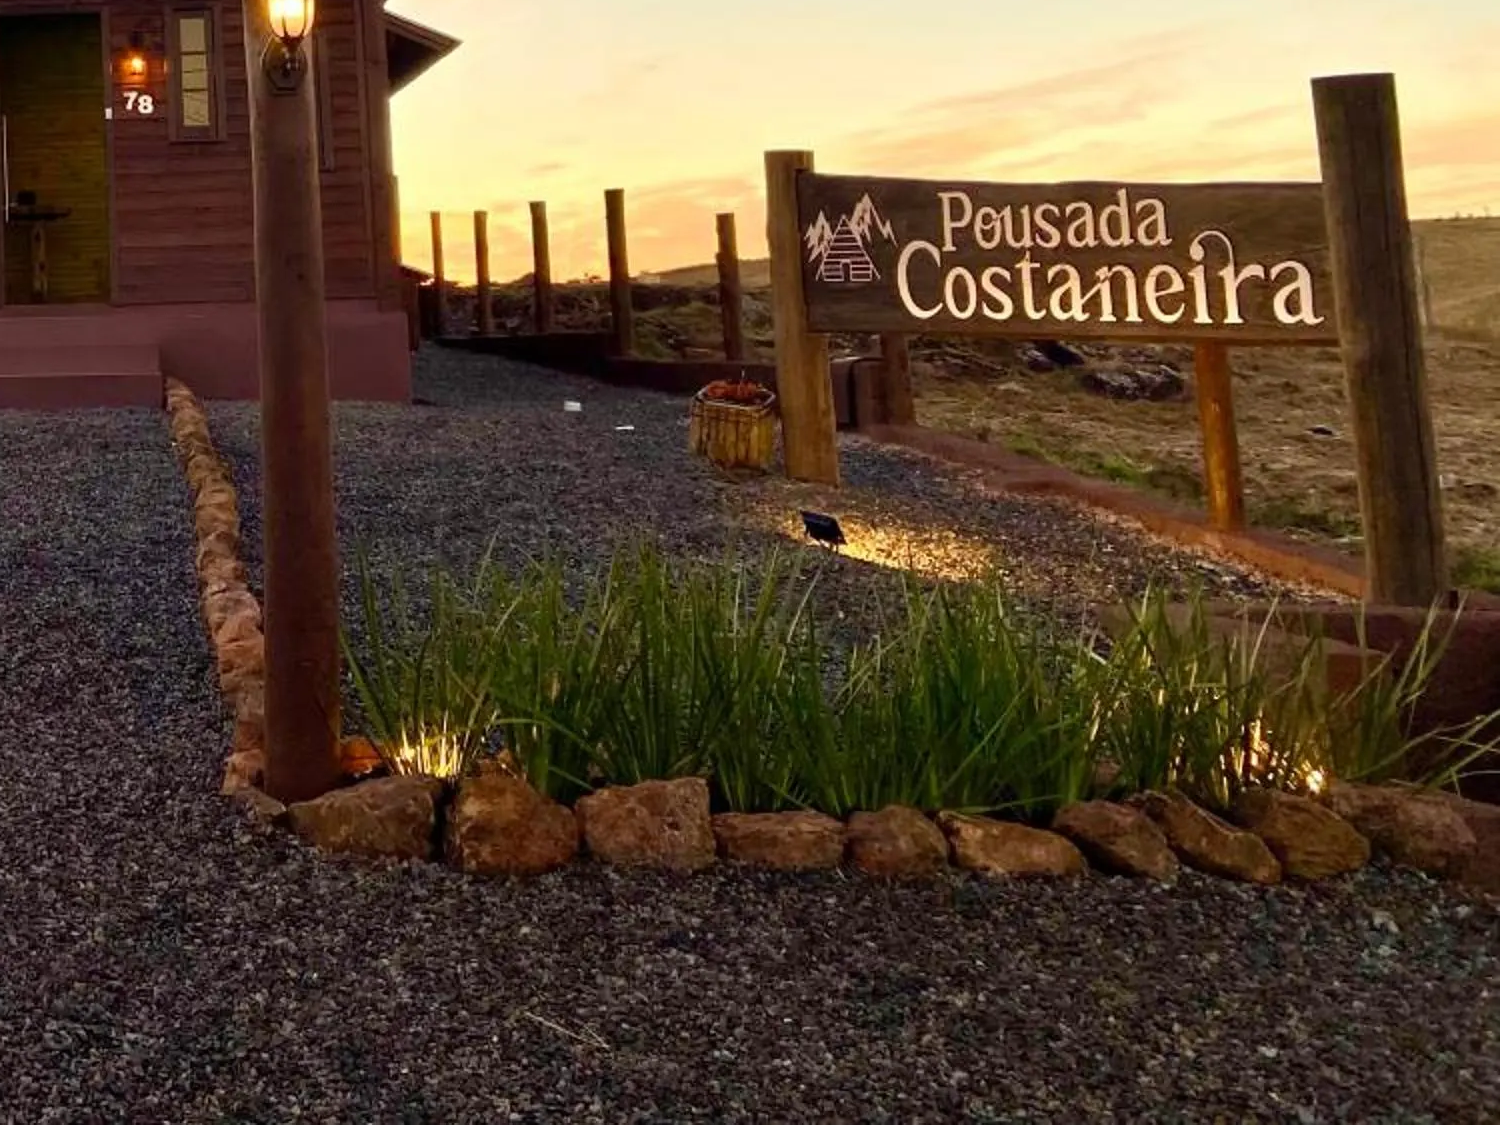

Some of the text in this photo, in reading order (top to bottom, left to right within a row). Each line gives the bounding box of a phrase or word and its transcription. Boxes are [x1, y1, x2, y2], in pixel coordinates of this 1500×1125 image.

[123, 90, 153, 114] 78
[938, 188, 1172, 252] Pousada
[897, 229, 1325, 326] Costaneira
